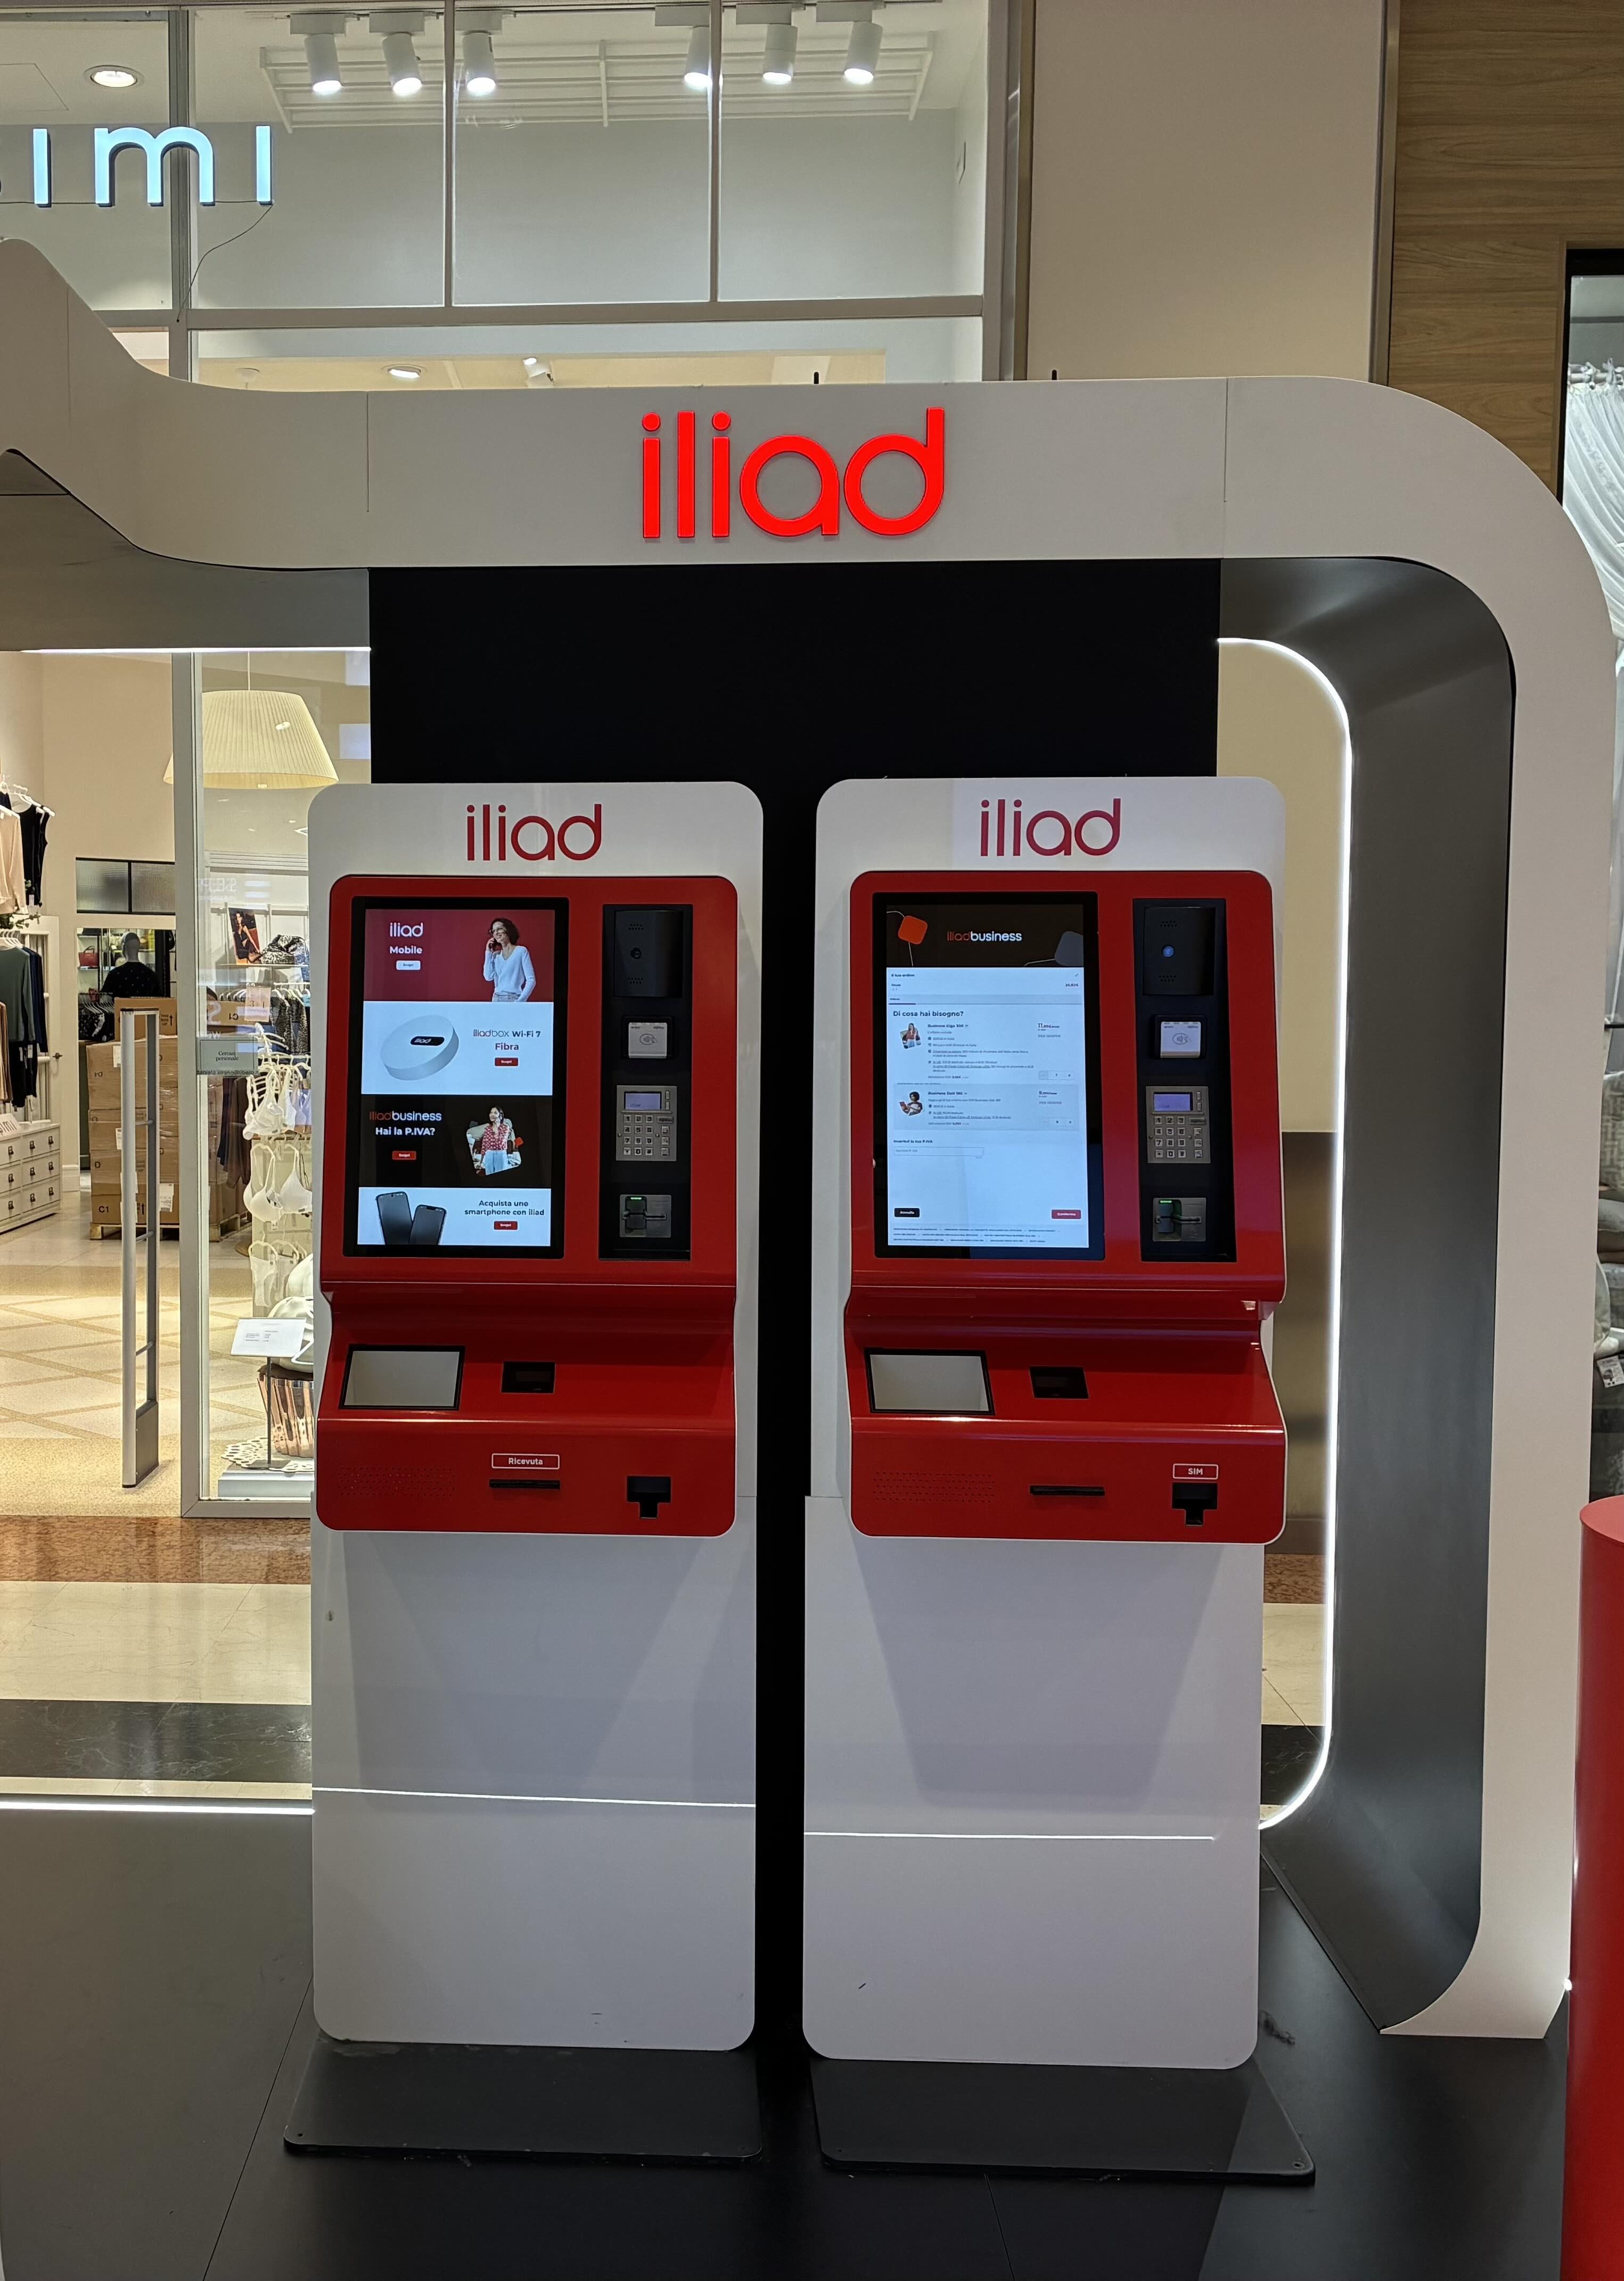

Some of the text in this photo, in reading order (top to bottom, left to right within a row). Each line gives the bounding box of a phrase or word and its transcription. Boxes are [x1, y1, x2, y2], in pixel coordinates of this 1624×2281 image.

[0, 125, 272, 207] imi
[642, 406, 945, 538] iliad
[466, 803, 602, 861] iliad
[980, 798, 1121, 857] iliad
[390, 922, 423, 937] iliad
[947, 931, 1022, 941] iliadbusiness
[390, 945, 423, 954] Mobile
[369, 1110, 442, 1121] iliadbusiness
[375, 1126, 436, 1136] Hai la P.IVA?
[508, 1457, 544, 1465] Ricevuta
